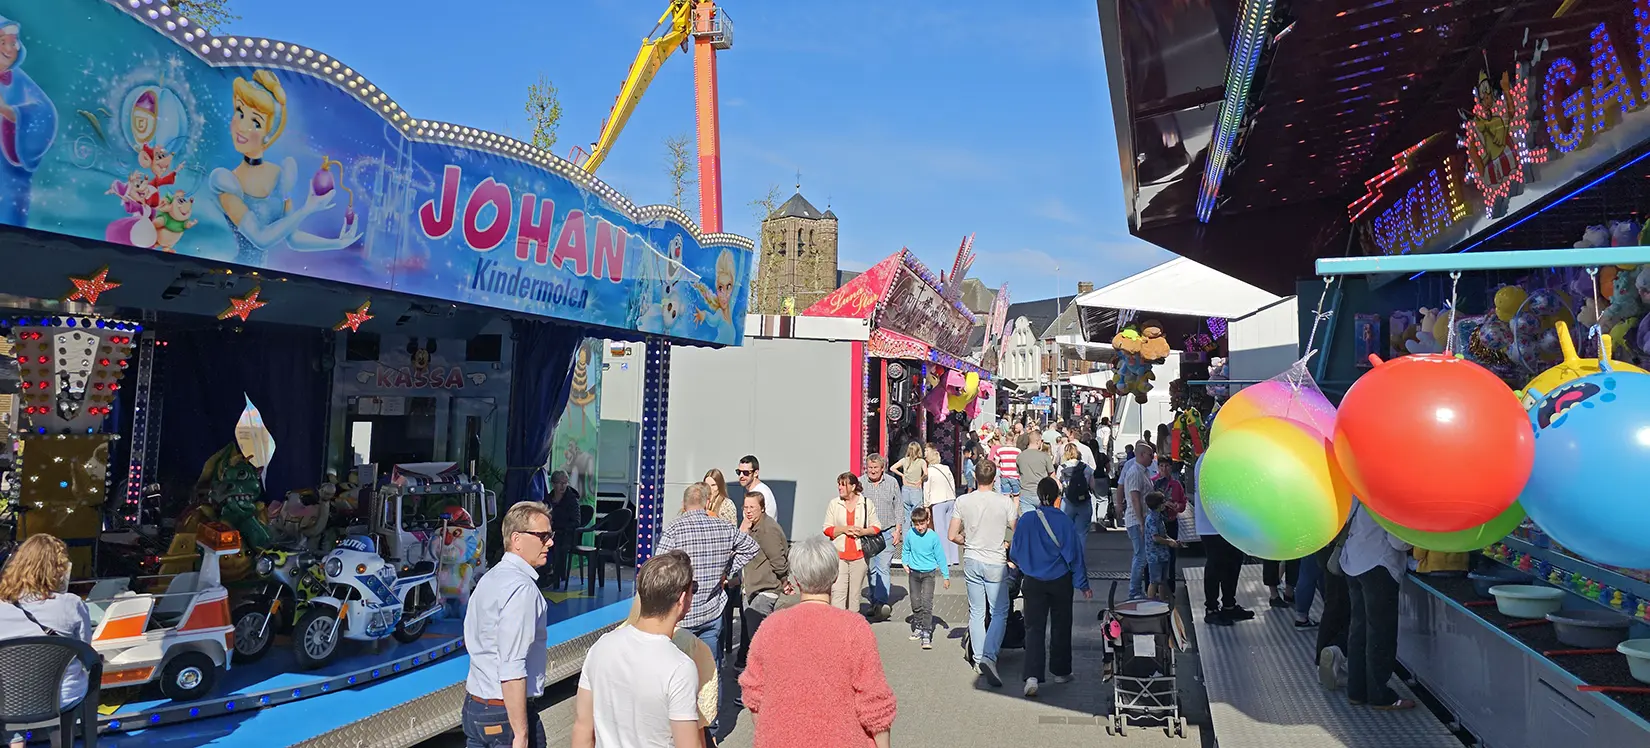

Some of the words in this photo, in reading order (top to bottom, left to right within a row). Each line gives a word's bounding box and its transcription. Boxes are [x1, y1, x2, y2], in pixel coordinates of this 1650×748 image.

[418, 164, 629, 284] JOHAN
[1374, 156, 1467, 256] SPECIAL
[471, 256, 589, 309] Kindermolen
[376, 366, 465, 389] KASSA
